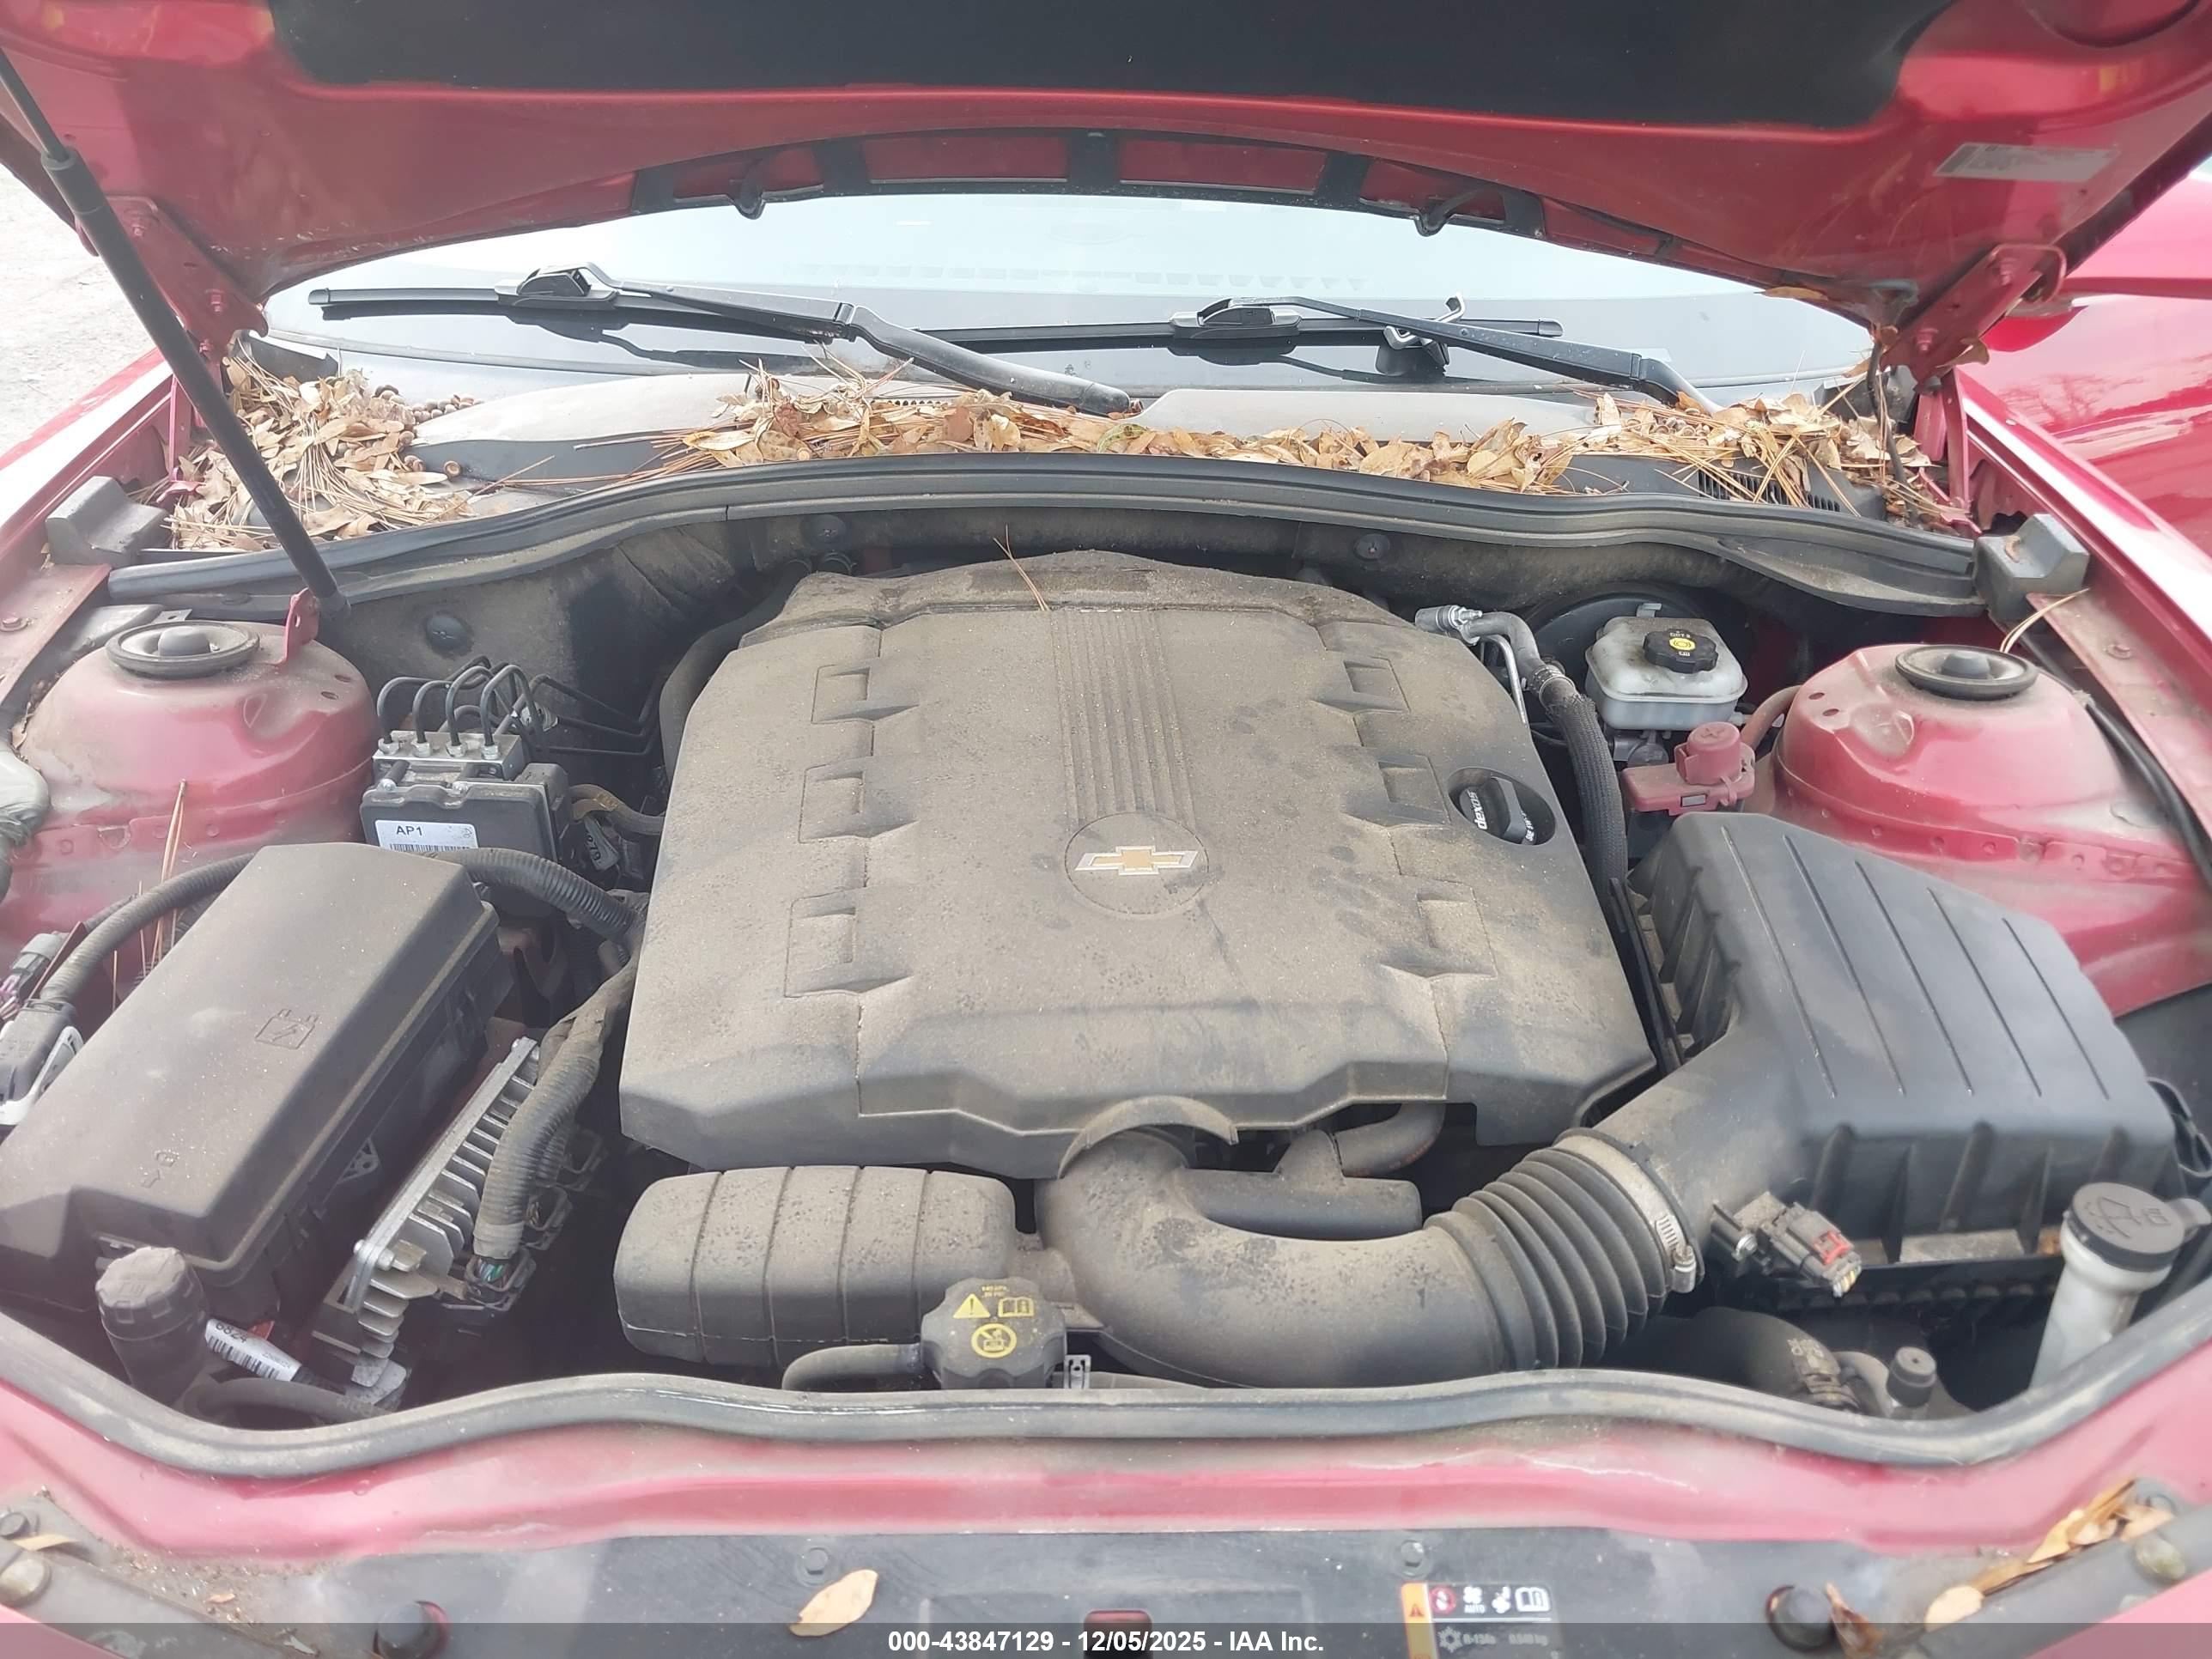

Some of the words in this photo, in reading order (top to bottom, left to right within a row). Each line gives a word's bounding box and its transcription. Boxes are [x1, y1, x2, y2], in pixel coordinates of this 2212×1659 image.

[1466, 789, 1488, 830] dexos
[396, 825, 423, 836] AP1
[1464, 1604, 1486, 1614] AUTO
